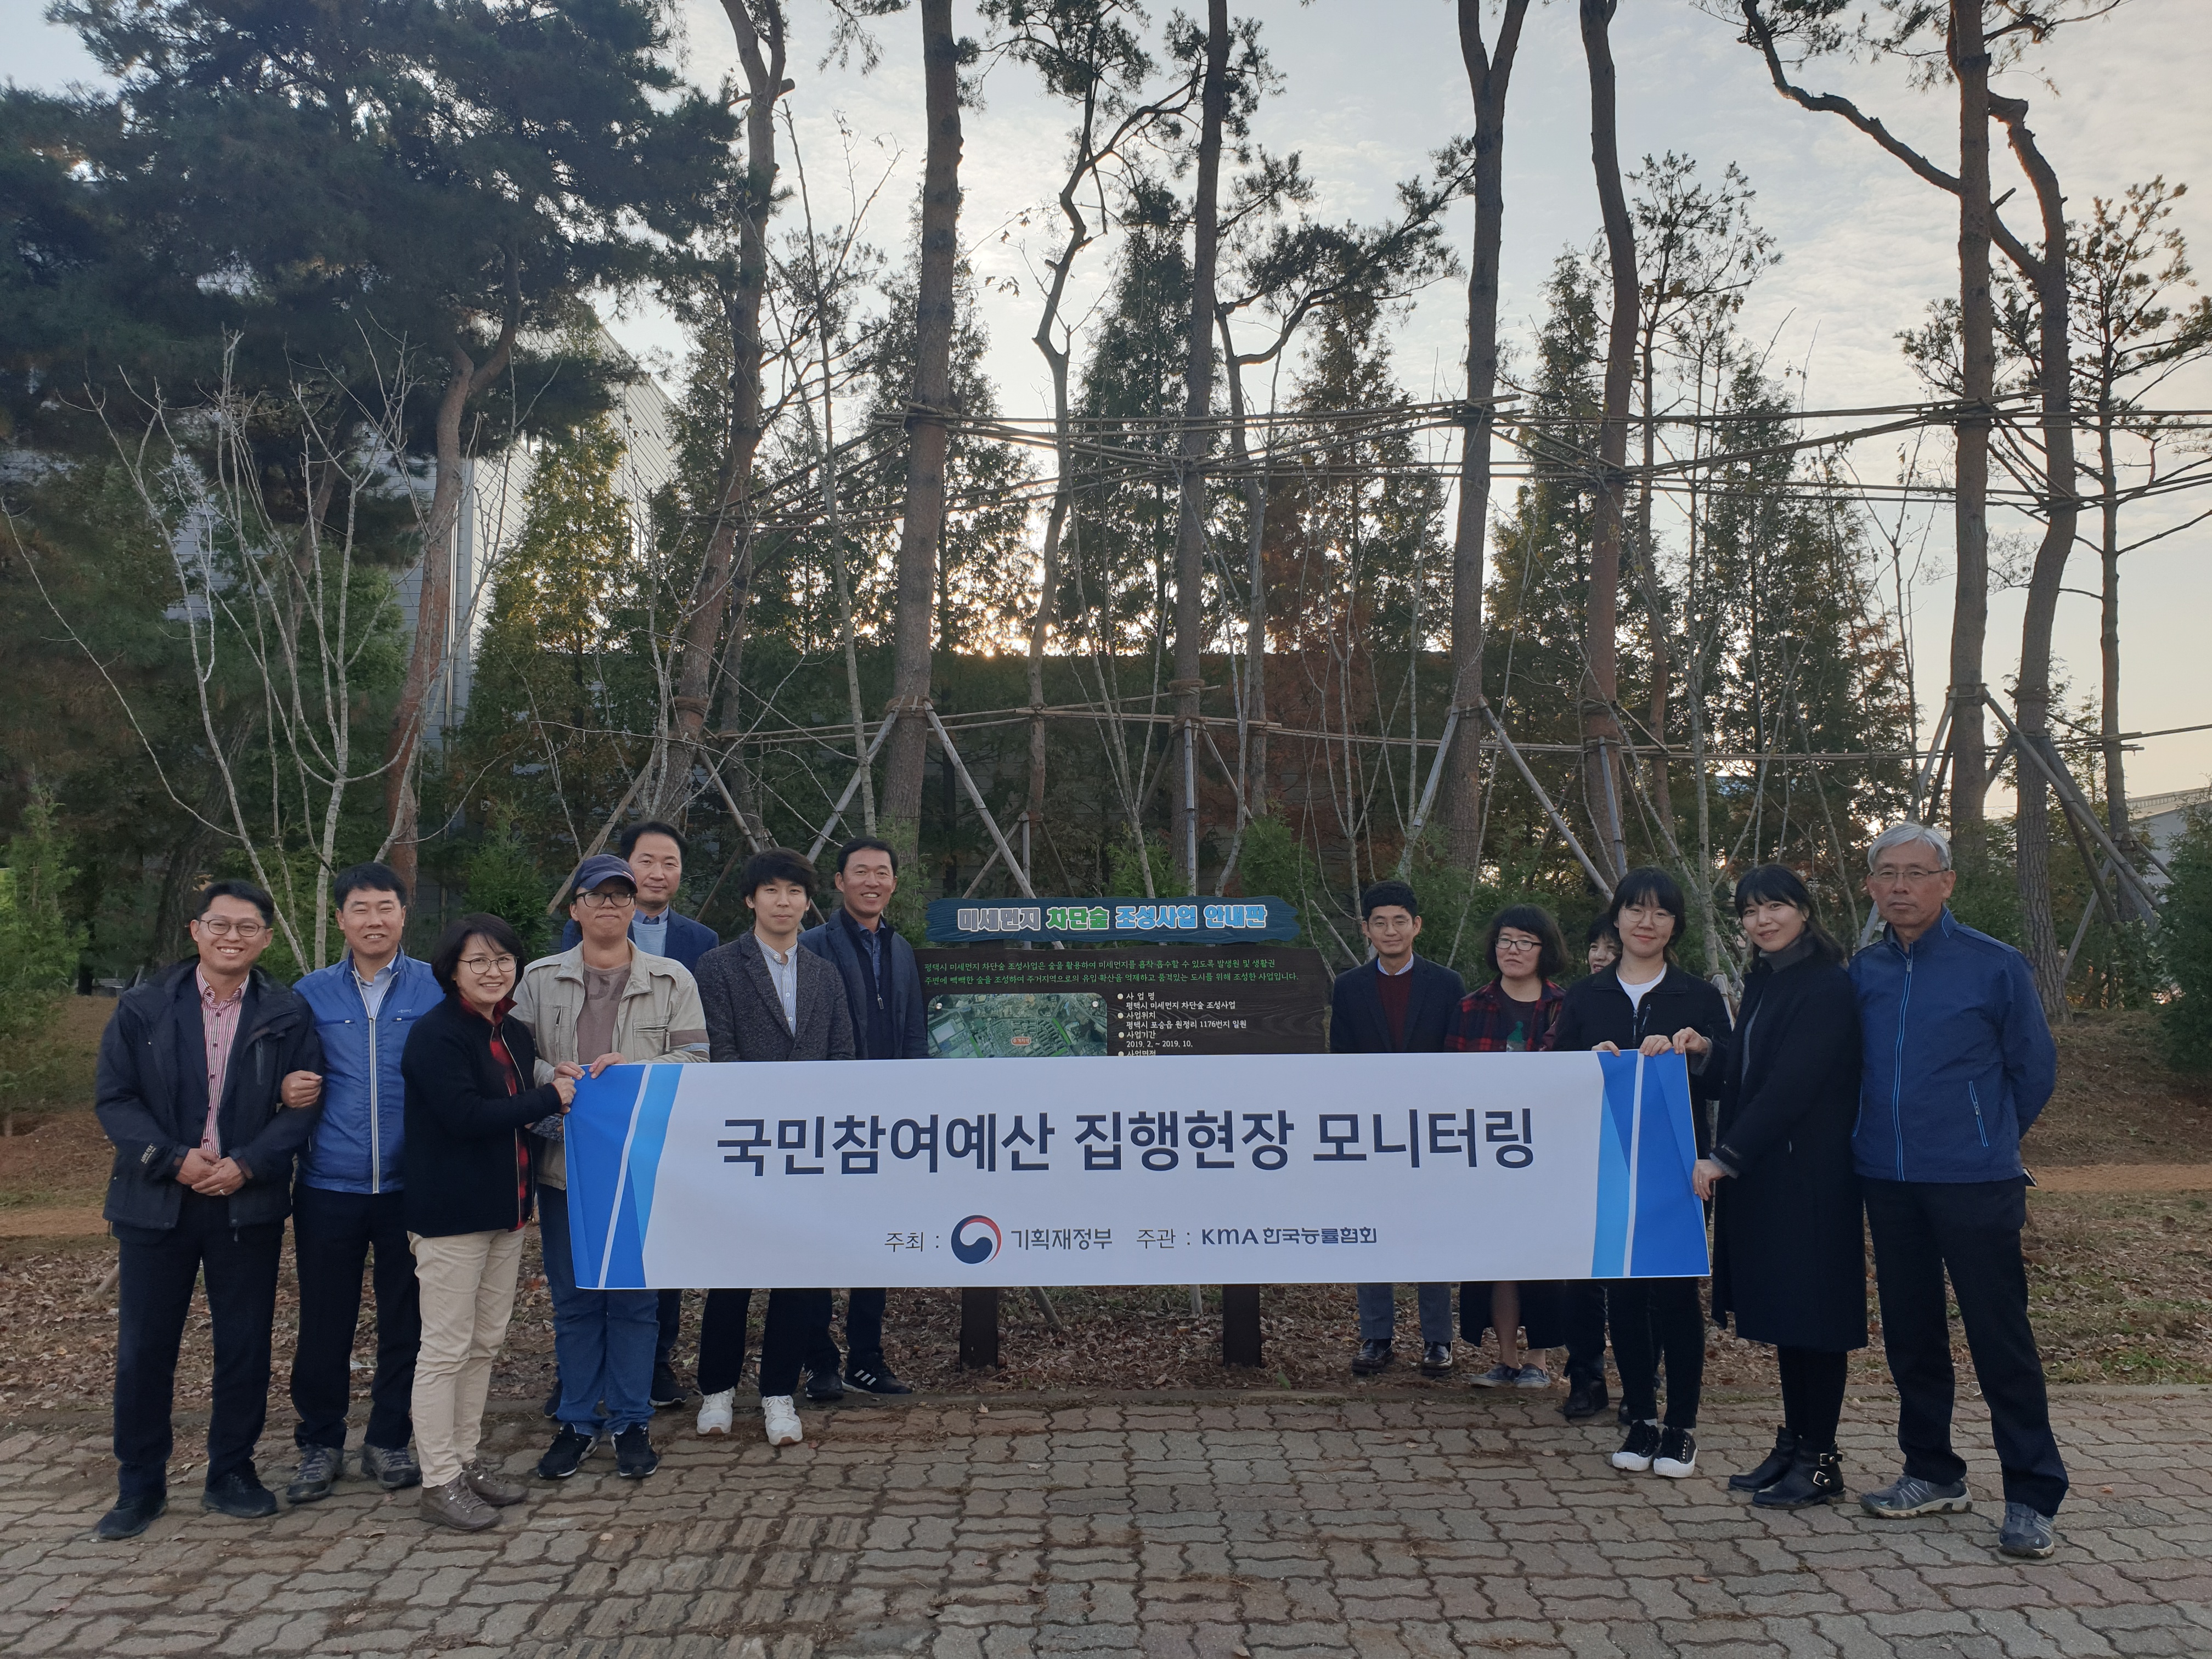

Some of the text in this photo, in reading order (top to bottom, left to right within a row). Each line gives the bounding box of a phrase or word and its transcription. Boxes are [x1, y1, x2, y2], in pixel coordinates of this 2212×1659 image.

[957, 905, 1267, 932] 미세먼지 차단숲 조성사업 안내판
[924, 962, 947, 972] 평택시
[950, 962, 979, 971] 미세먼지
[982, 962, 1006, 970] 차단숲
[1008, 962, 1046, 970] 조성사업은
[1048, 961, 1063, 970] 숲을
[1066, 961, 1096, 970] 활용하여
[1099, 960, 1136, 969] 미세먼지를
[1182, 960, 1189, 968] 수
[1192, 960, 1215, 968] 있도록
[1217, 960, 1239, 968] 발생원
[1243, 960, 1250, 968] 및
[1252, 959, 1275, 968] 생활권
[924, 976, 947, 985] 주변에
[976, 975, 992, 984] 숲을
[994, 975, 1024, 984] 조성하여
[1026, 974, 1079, 983] 주거지역으로의
[1125, 973, 1155, 982] 억제하고
[1158, 973, 1188, 982] 품격있는
[1190, 973, 1213, 981] 도시를
[1215, 973, 1231, 981] 위해
[1233, 972, 1256, 981] 조성한
[1259, 972, 1299, 981] 사업입니다.
[1126, 1001, 1235, 1010] 평택시 미세먼지 차단숲 조성사업
[1126, 1011, 1155, 1020] 사업위치
[1126, 1020, 1246, 1030] 평택시 포승읍 원정리 1176번지 일원
[1127, 1030, 1156, 1039] 사업기간
[717, 1108, 1533, 1176] 국민참여예산 집행현장 모니터링
[884, 1232, 924, 1252] 주최
[1011, 1228, 1113, 1250] 기획재정부
[1136, 1228, 1176, 1249] 주관
[1263, 1226, 1378, 1245] 한국능률협회
